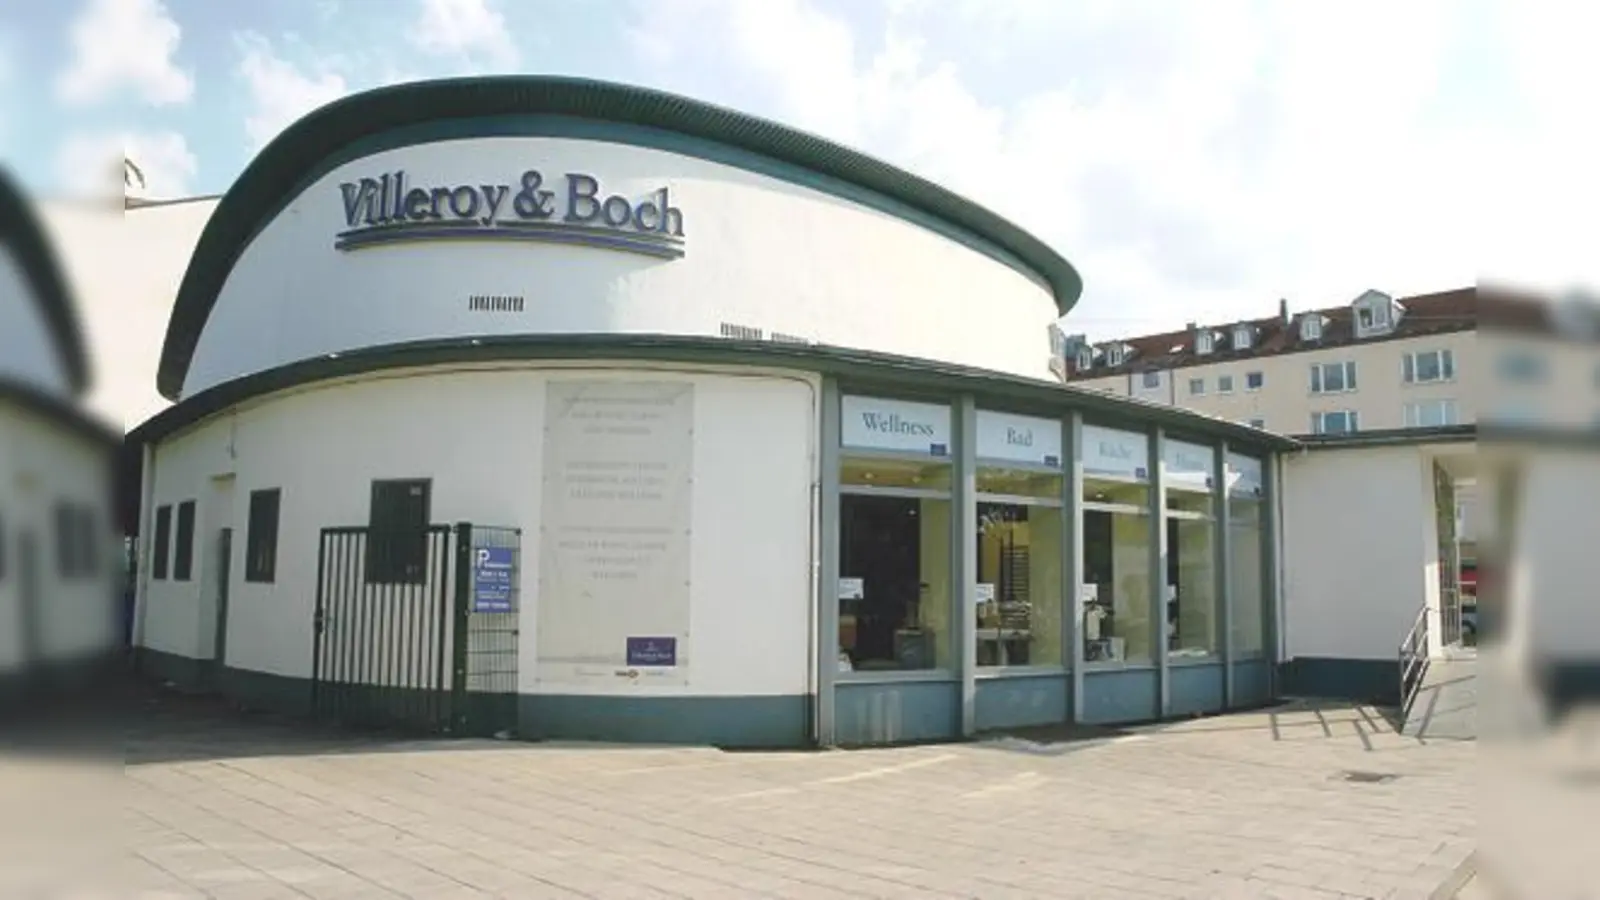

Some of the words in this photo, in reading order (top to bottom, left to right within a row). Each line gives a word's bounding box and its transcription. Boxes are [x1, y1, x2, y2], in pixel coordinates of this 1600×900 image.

[339, 169, 510, 228] Villeroy
[513, 169, 556, 219] &
[563, 172, 686, 238] Boch
[861, 411, 935, 436] Wellness
[1005, 426, 1034, 447] Bad
